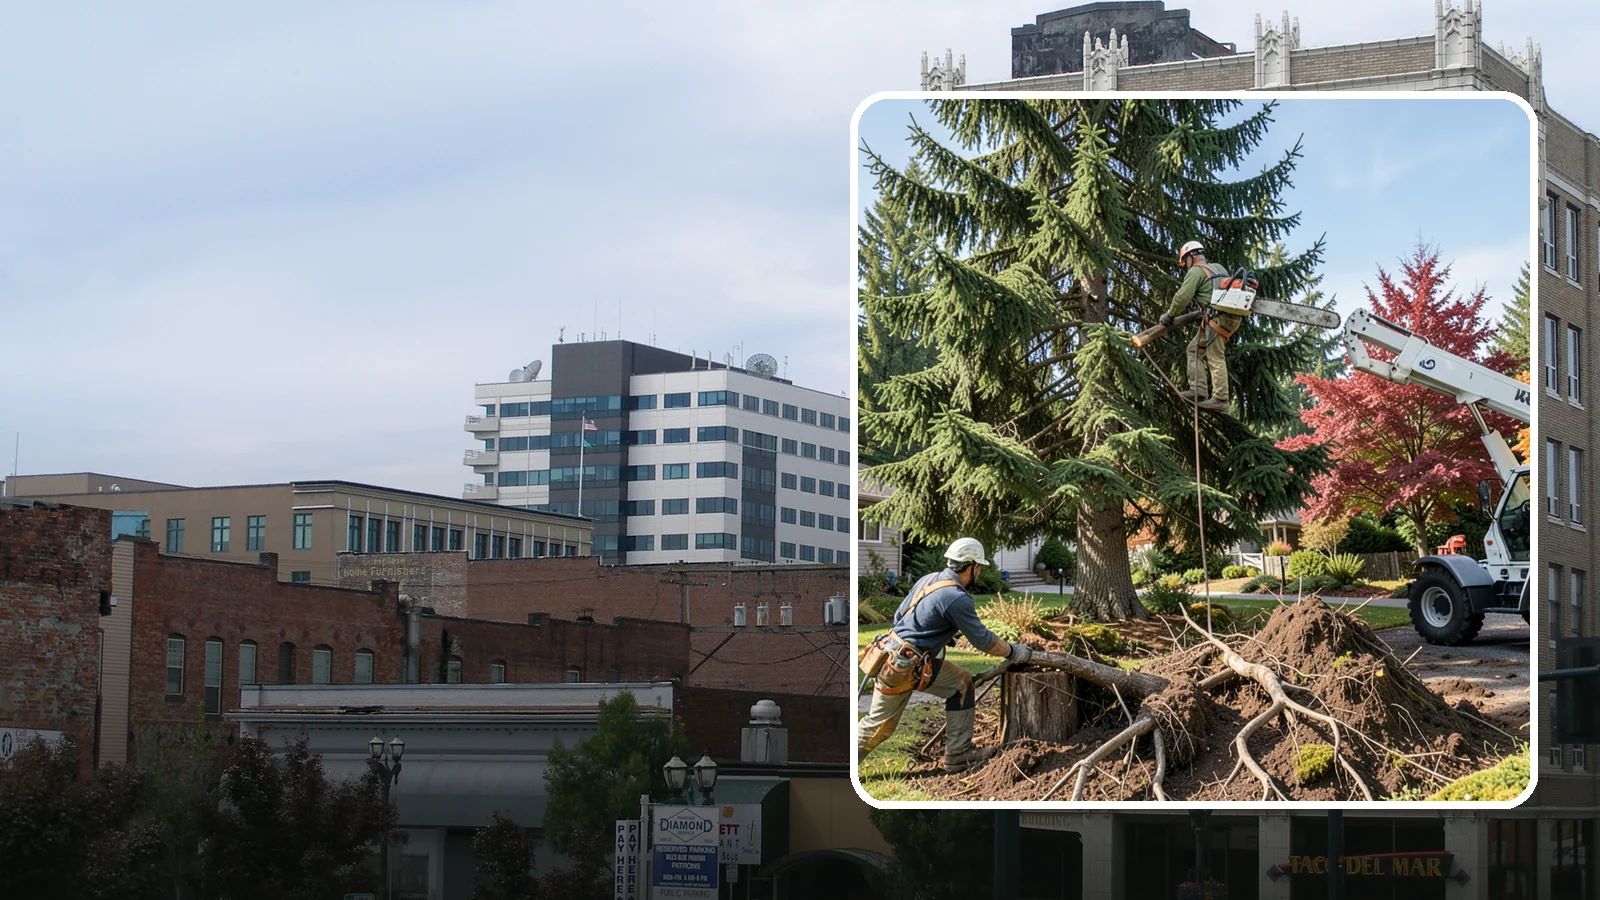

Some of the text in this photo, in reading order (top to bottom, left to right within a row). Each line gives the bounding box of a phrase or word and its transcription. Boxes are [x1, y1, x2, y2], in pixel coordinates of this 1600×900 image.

[343, 566, 426, 577] Home Furnishers
[660, 818, 713, 832] DIAMOND
[1021, 815, 1070, 827] BUILDING
[656, 845, 716, 854] RESERVED PARKING
[616, 825, 625, 893] PAY HERE
[627, 825, 637, 893] PAY HERE
[721, 851, 739, 862] Soup
[671, 862, 701, 870] PATRONS
[1345, 855, 1385, 876] DEL
[1392, 857, 1442, 877] MAR
[660, 888, 710, 898] PUBLIC PARKING
